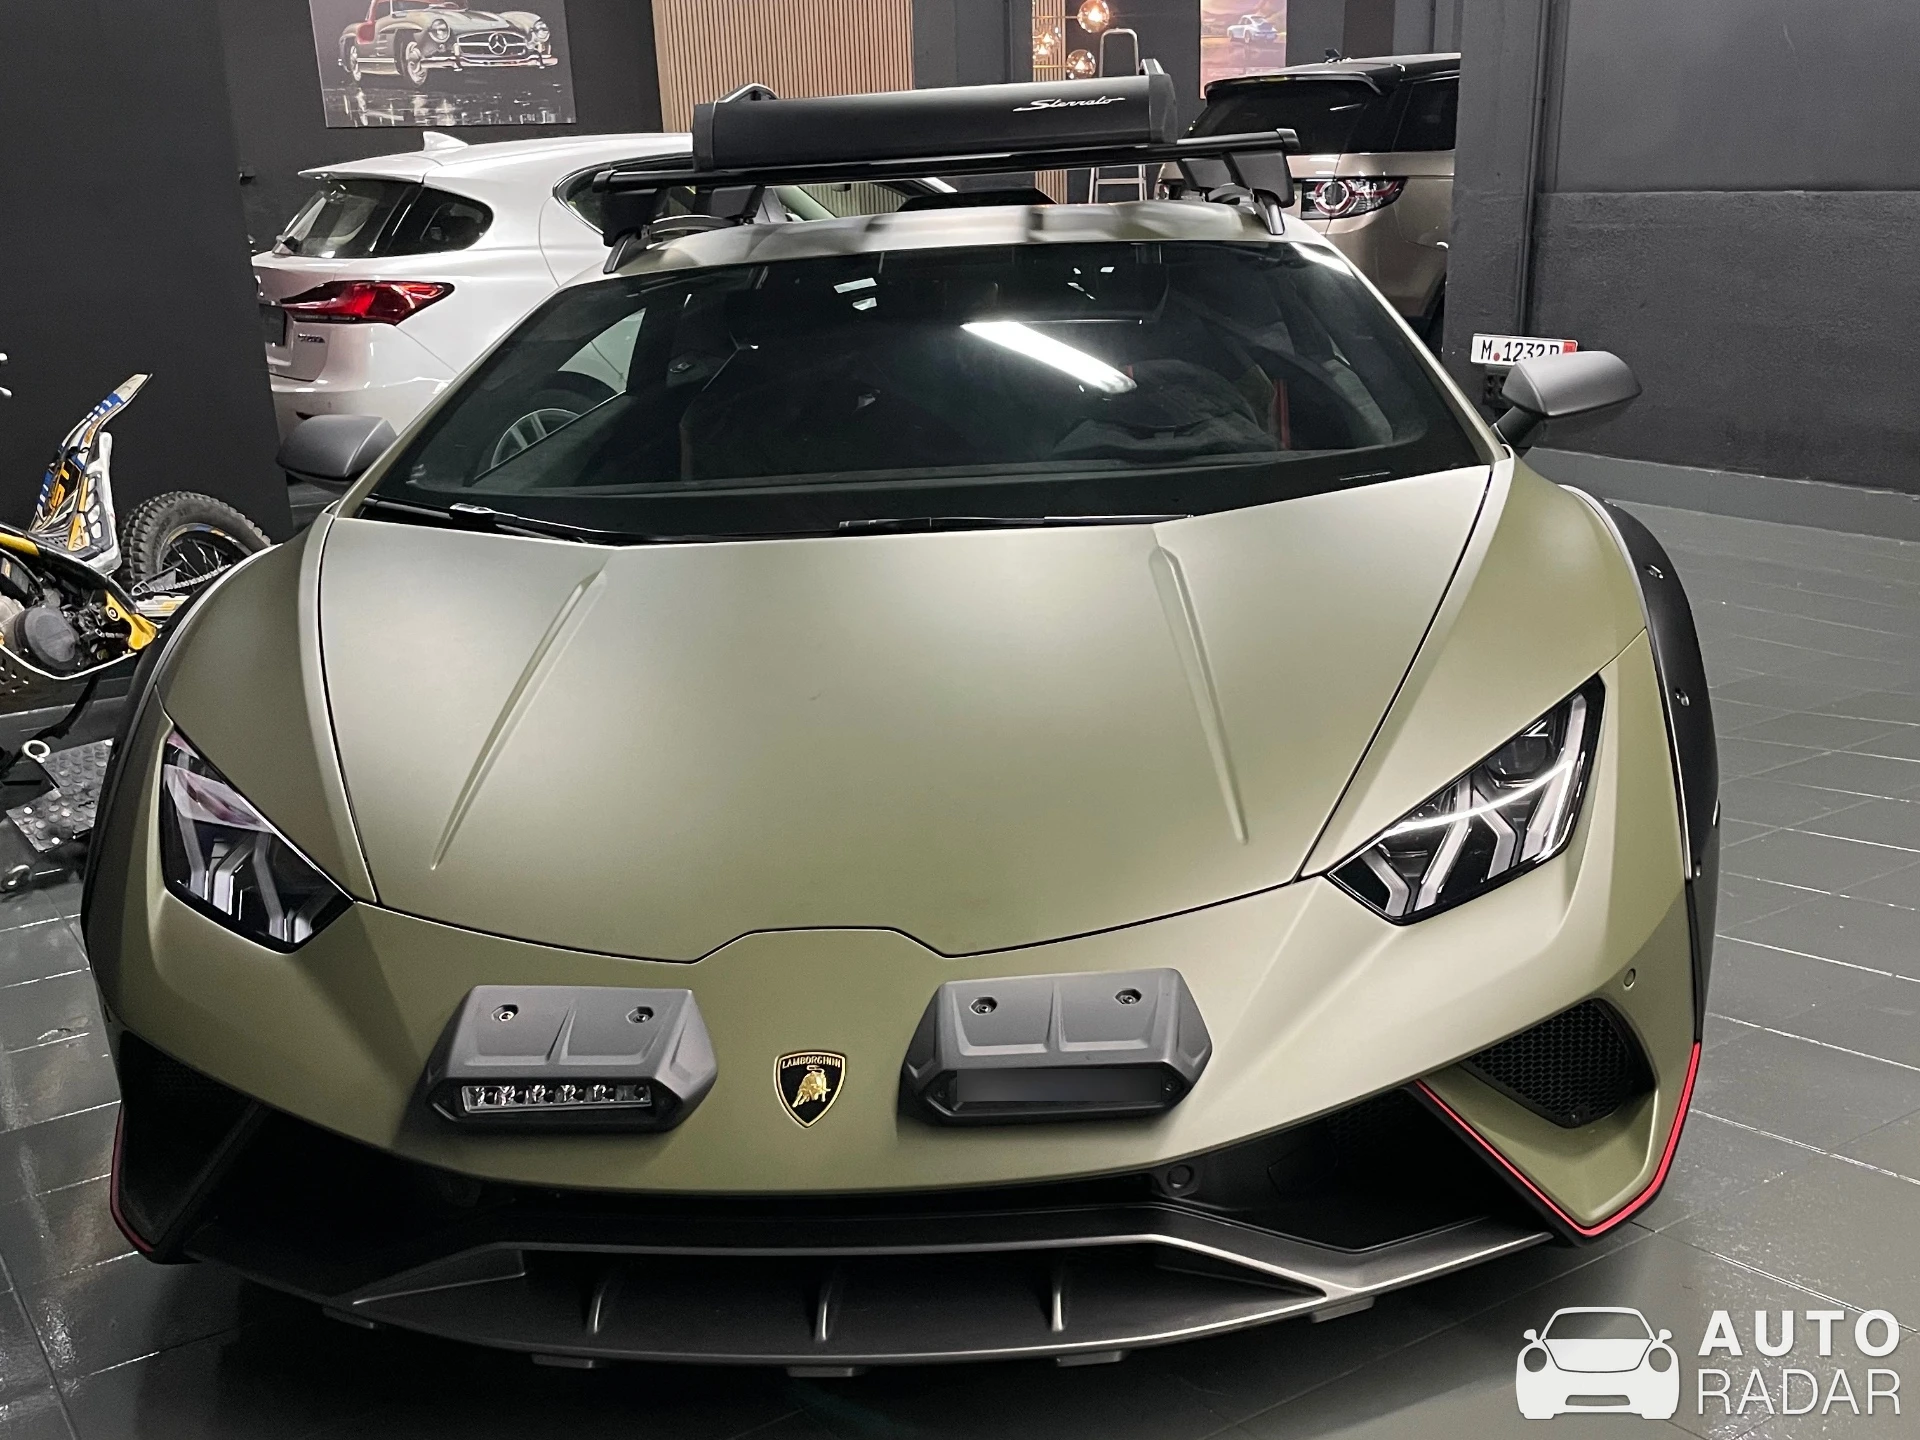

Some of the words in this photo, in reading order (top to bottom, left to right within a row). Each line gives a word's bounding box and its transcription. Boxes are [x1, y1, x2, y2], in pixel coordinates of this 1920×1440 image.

[1013, 96, 1125, 112] Sterrato
[1481, 340, 1493, 360] M
[782, 1056, 841, 1069] LAMBORGHINI
